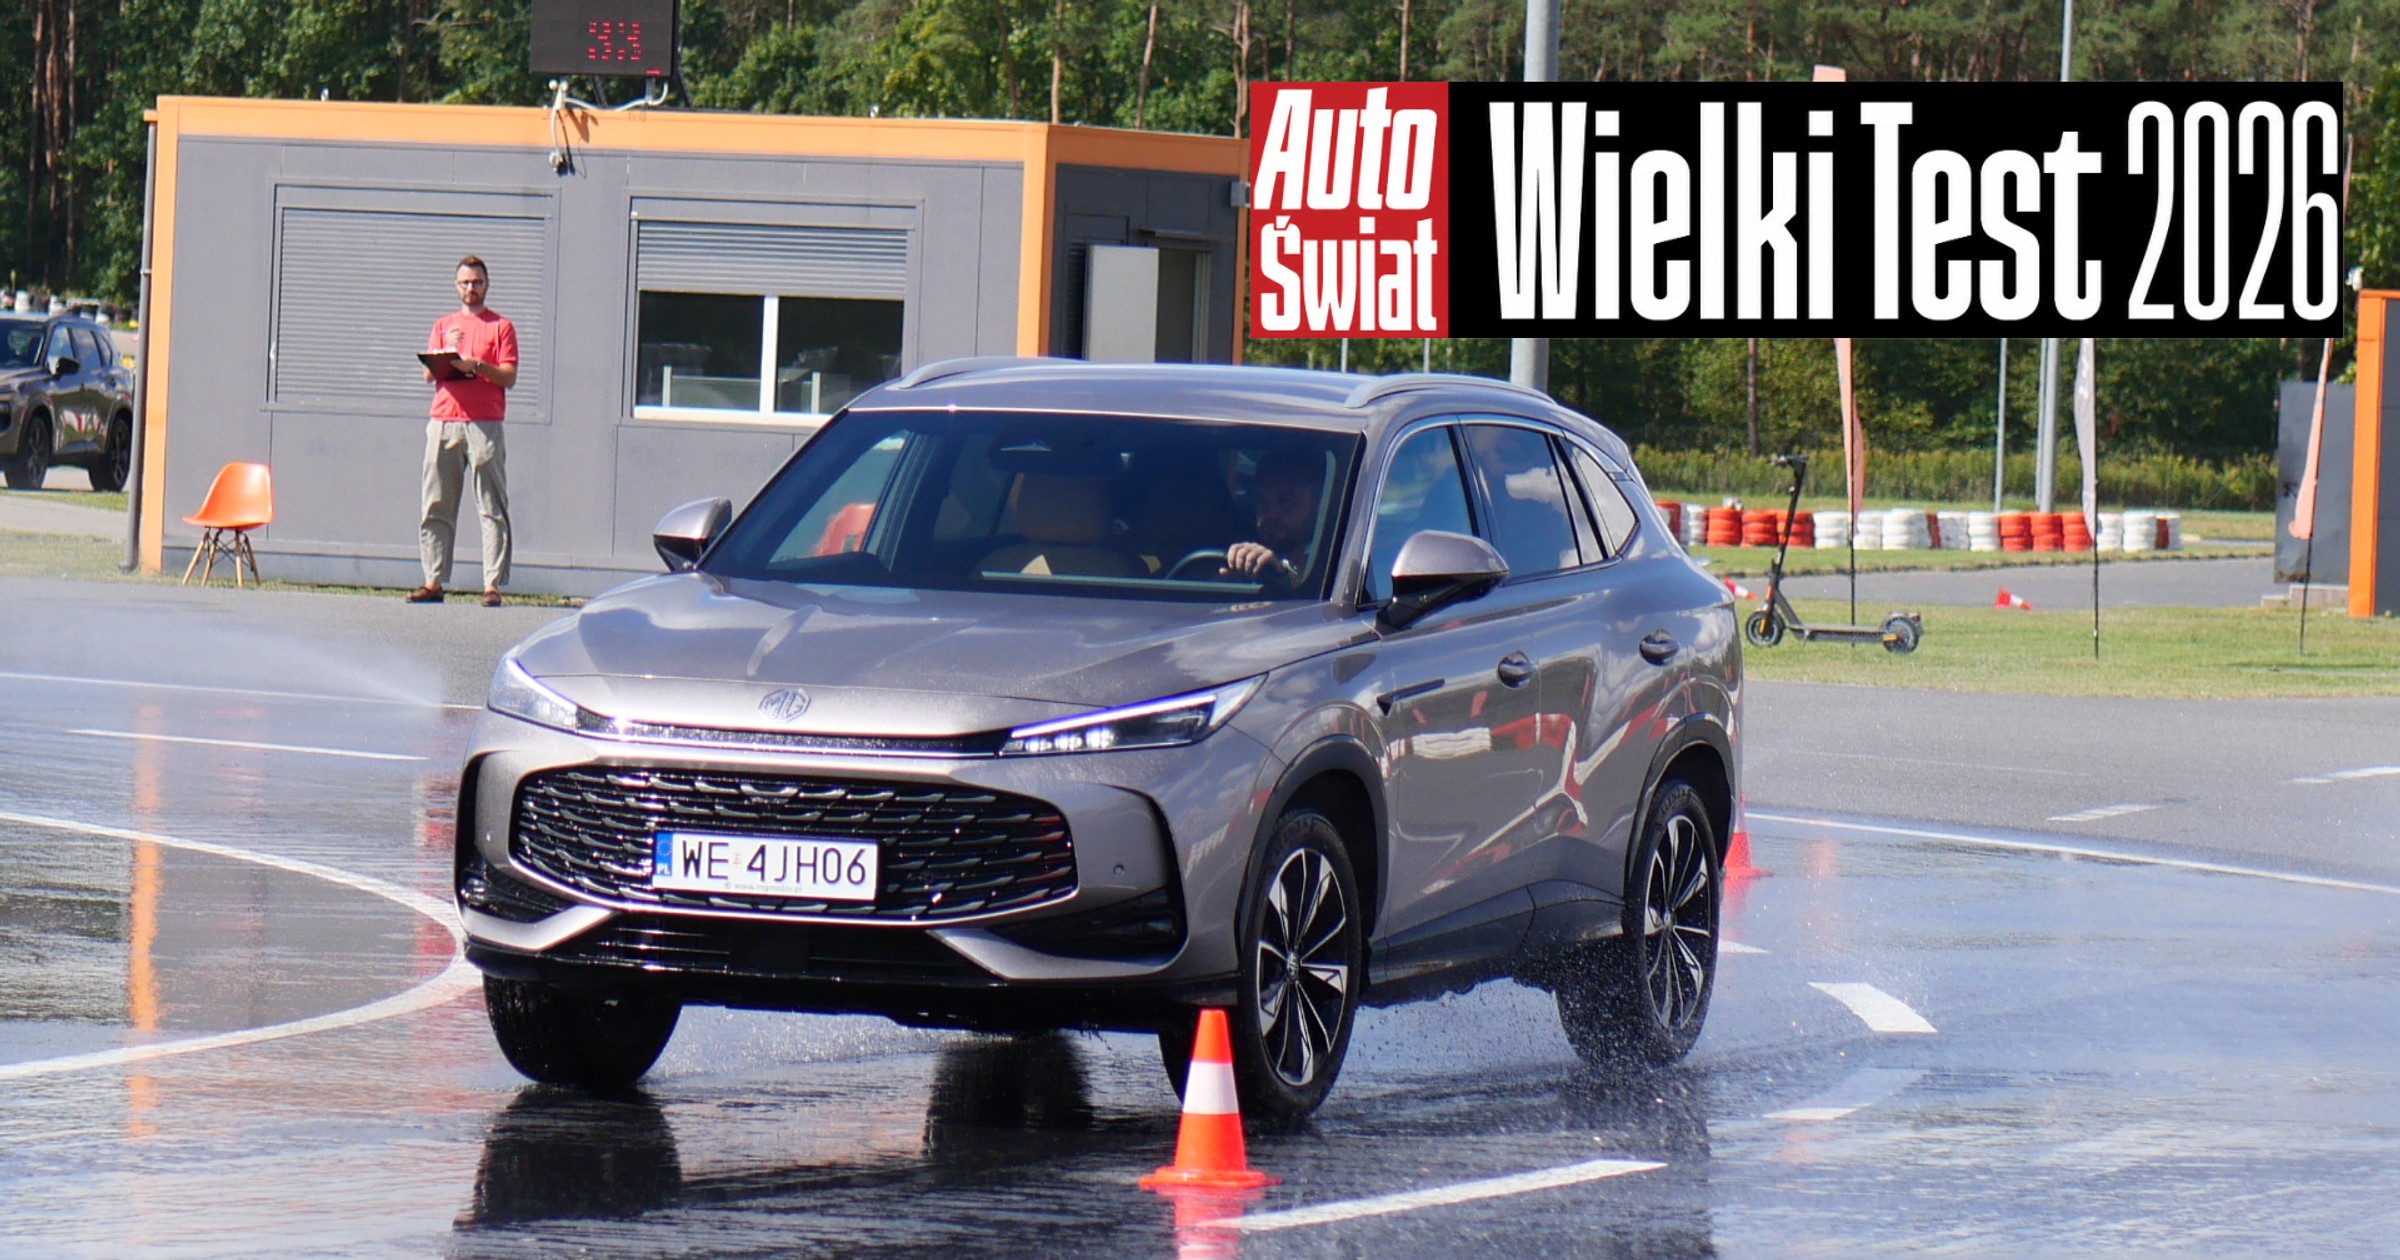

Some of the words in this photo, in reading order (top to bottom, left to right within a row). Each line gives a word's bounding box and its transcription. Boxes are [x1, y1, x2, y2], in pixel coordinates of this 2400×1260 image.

[759, 688, 811, 722] MG
[656, 862, 671, 876] PL
[682, 839, 729, 880] WE
[746, 843, 867, 886] 4JH06
